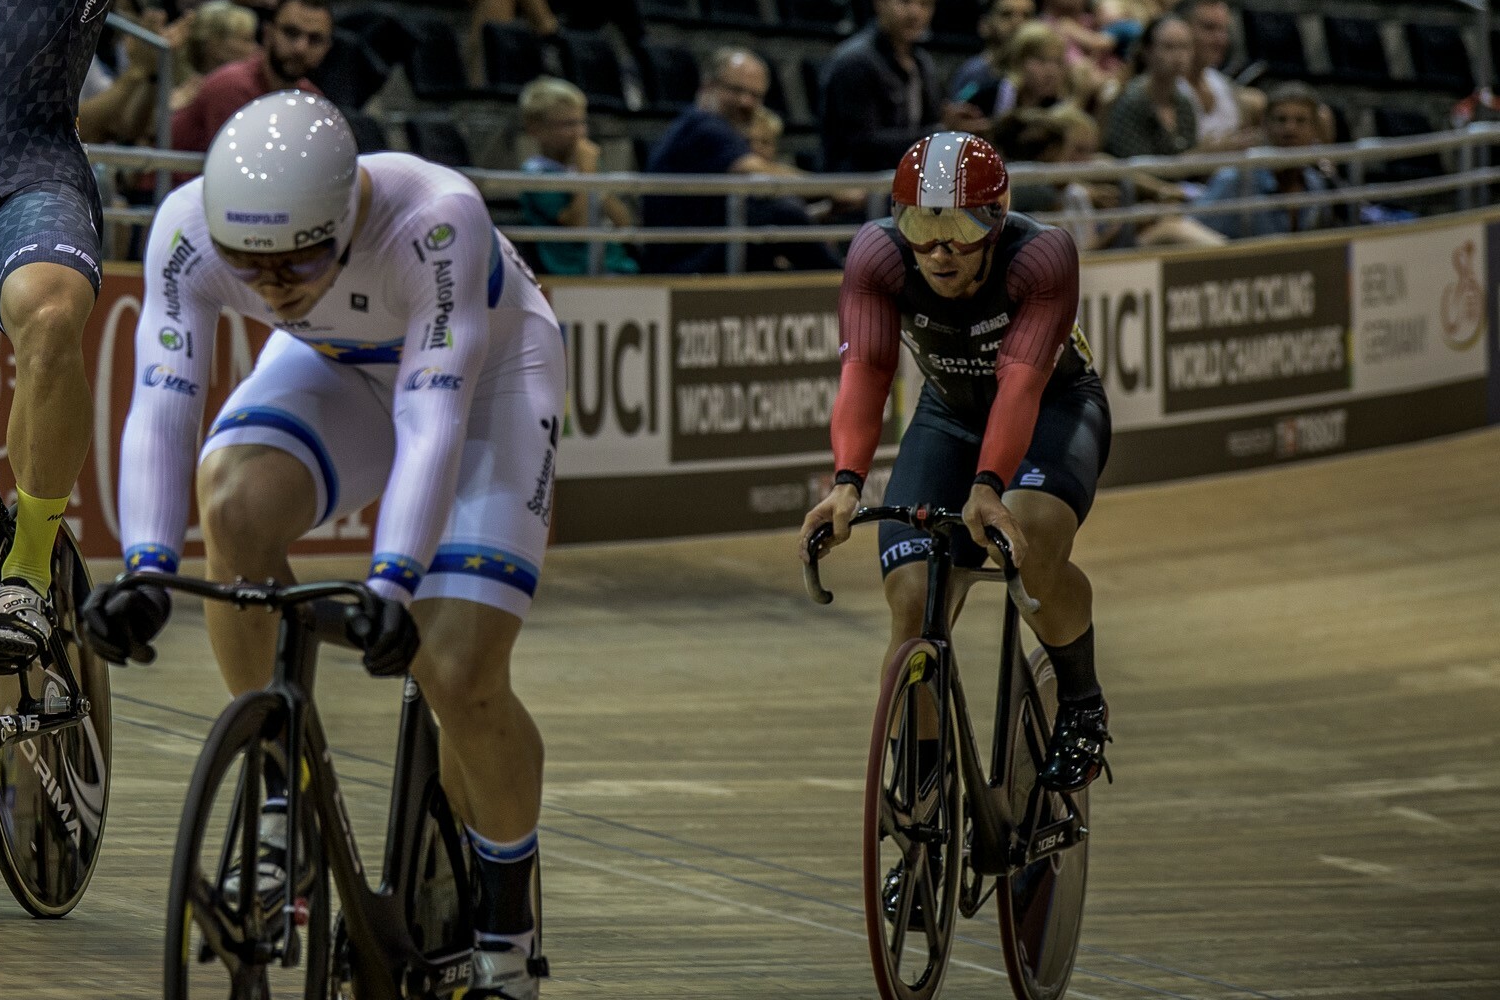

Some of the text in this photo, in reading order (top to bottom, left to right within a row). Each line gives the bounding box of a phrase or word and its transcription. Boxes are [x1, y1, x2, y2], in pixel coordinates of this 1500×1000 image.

[162, 234, 197, 323] AutoPoint
[430, 260, 455, 350] AutoPoint
[163, 374, 200, 398] UEC
[571, 320, 659, 438] UCI
[1169, 337, 1222, 391] WORLD
[677, 382, 744, 436] WORLD
[18, 737, 83, 851] ORIMA
